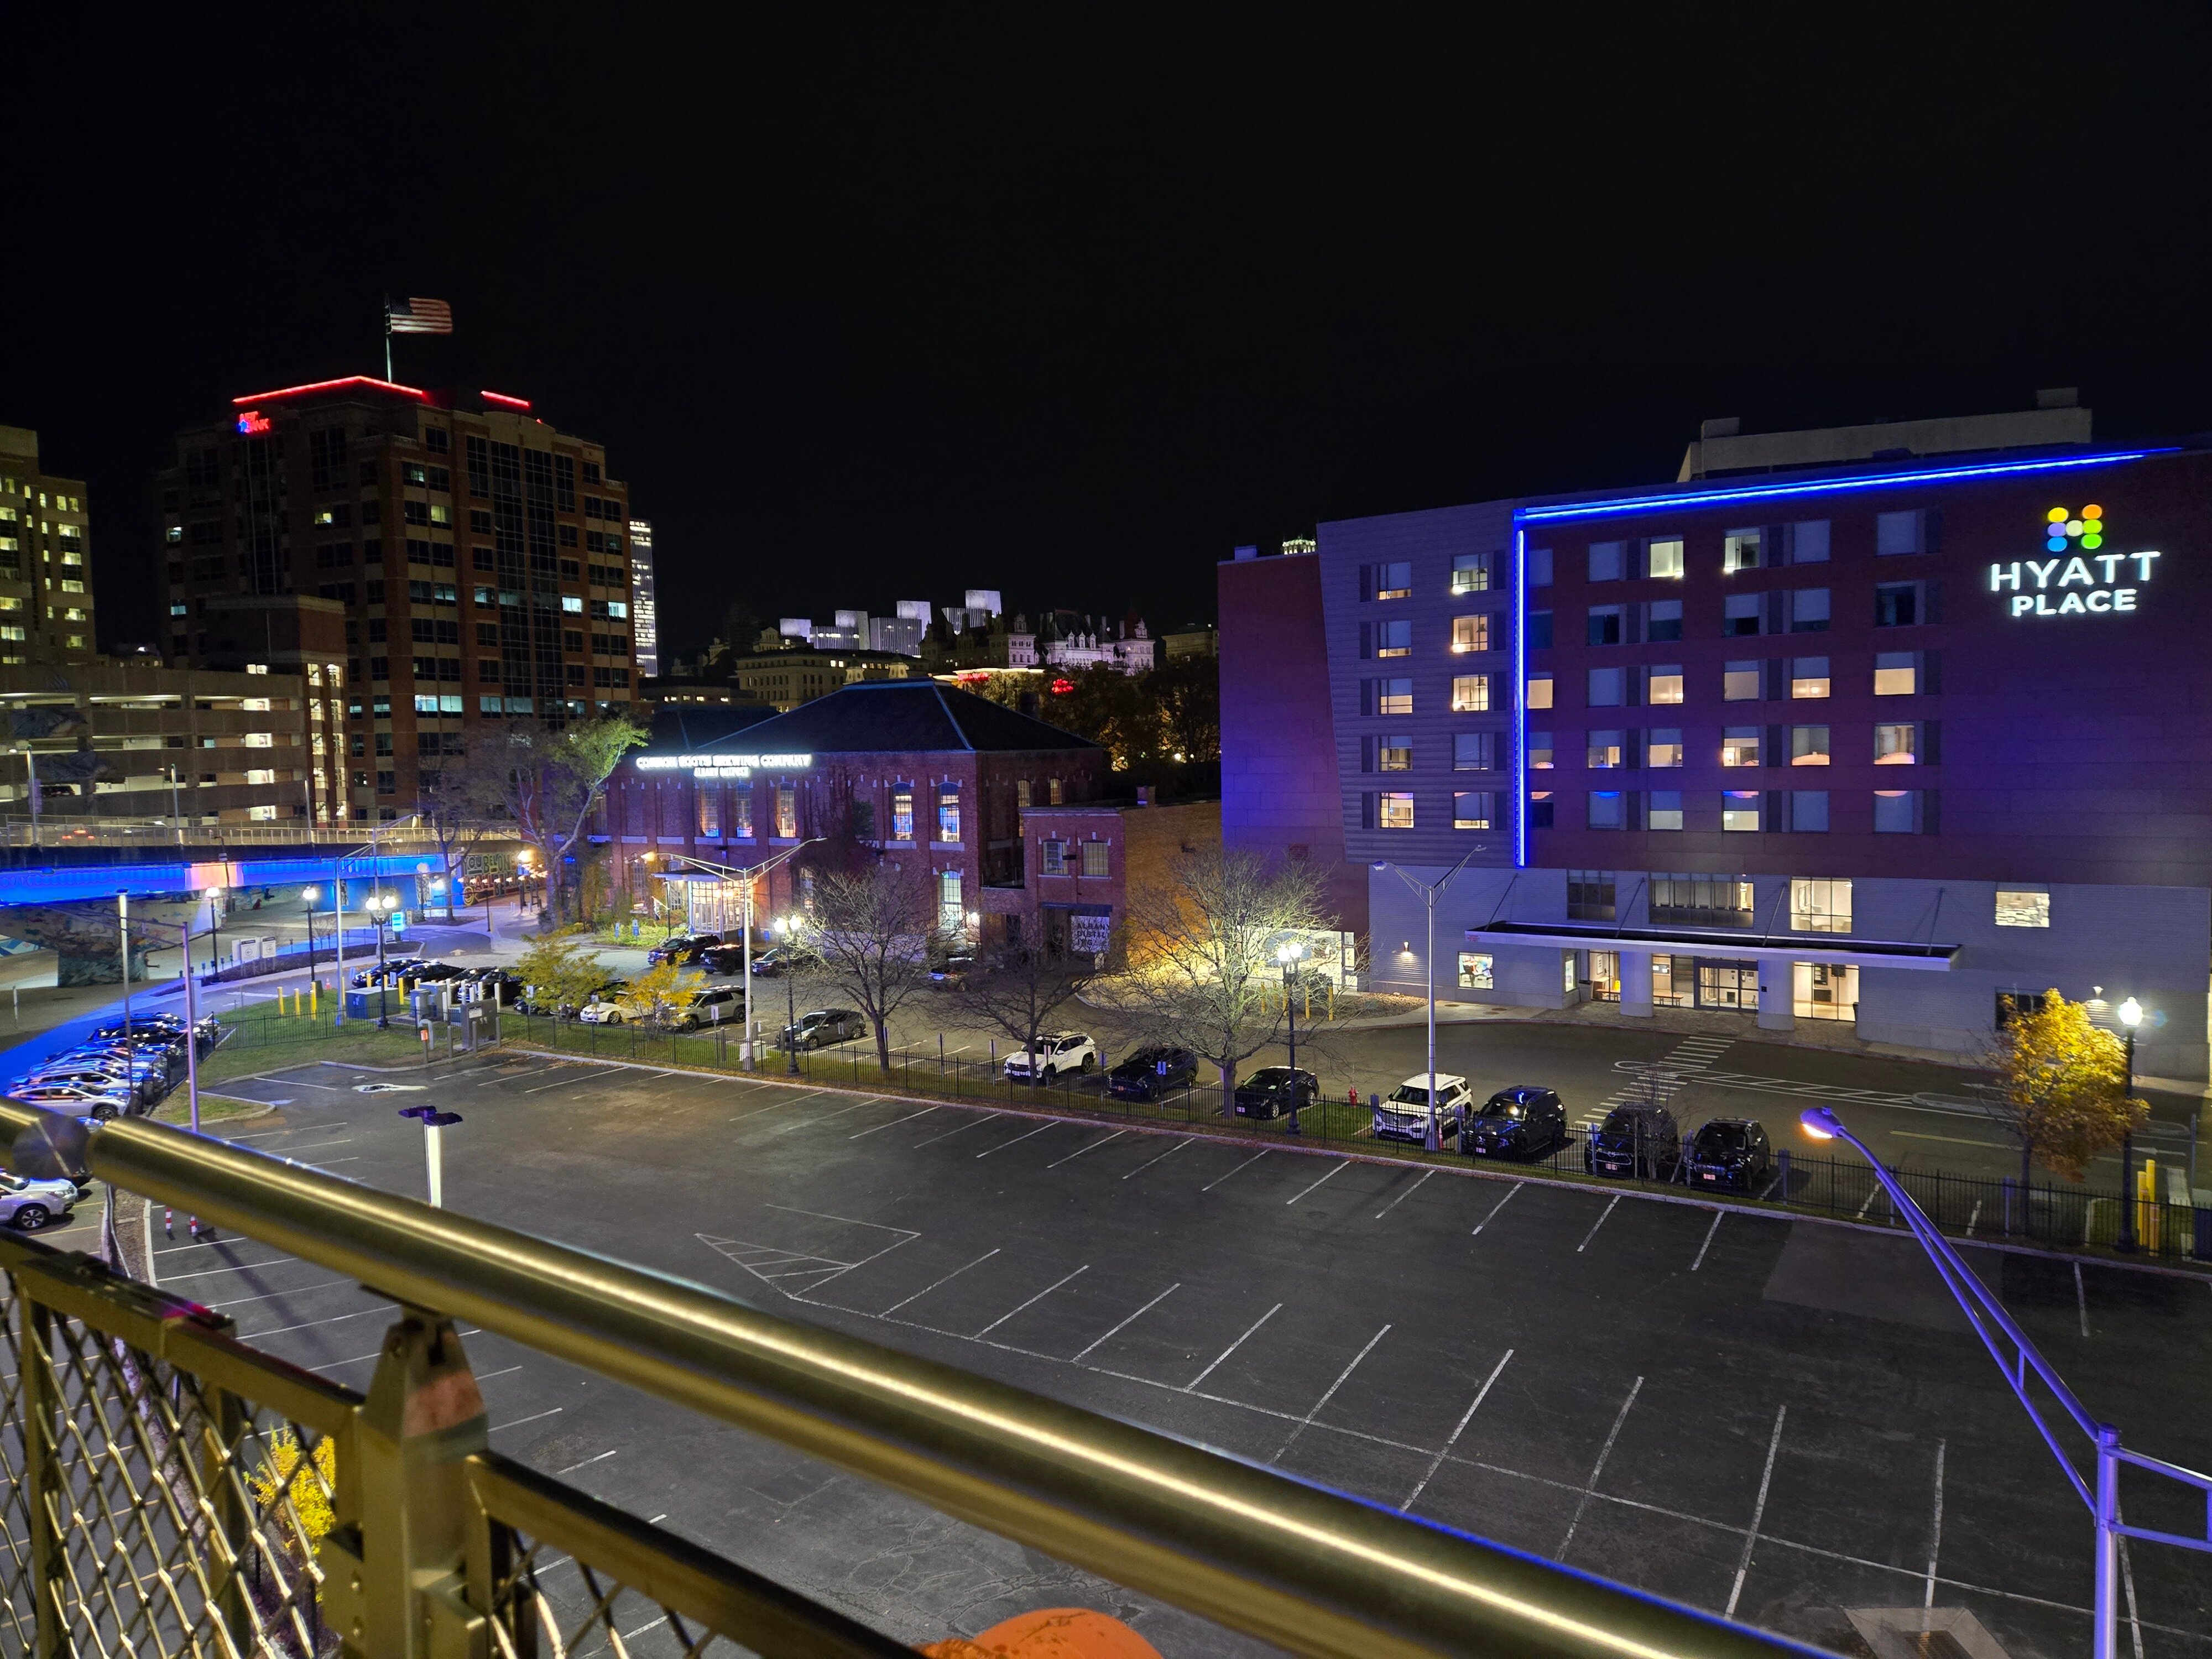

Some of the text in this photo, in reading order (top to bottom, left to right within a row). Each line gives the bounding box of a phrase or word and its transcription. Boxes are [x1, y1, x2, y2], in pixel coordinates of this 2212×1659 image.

[1991, 551, 2161, 591] HYATT
[2011, 588, 2137, 617] PLACE
[636, 754, 811, 769] COMMON ROOTS BREWING COMPANY
[463, 855, 482, 874] YOU
